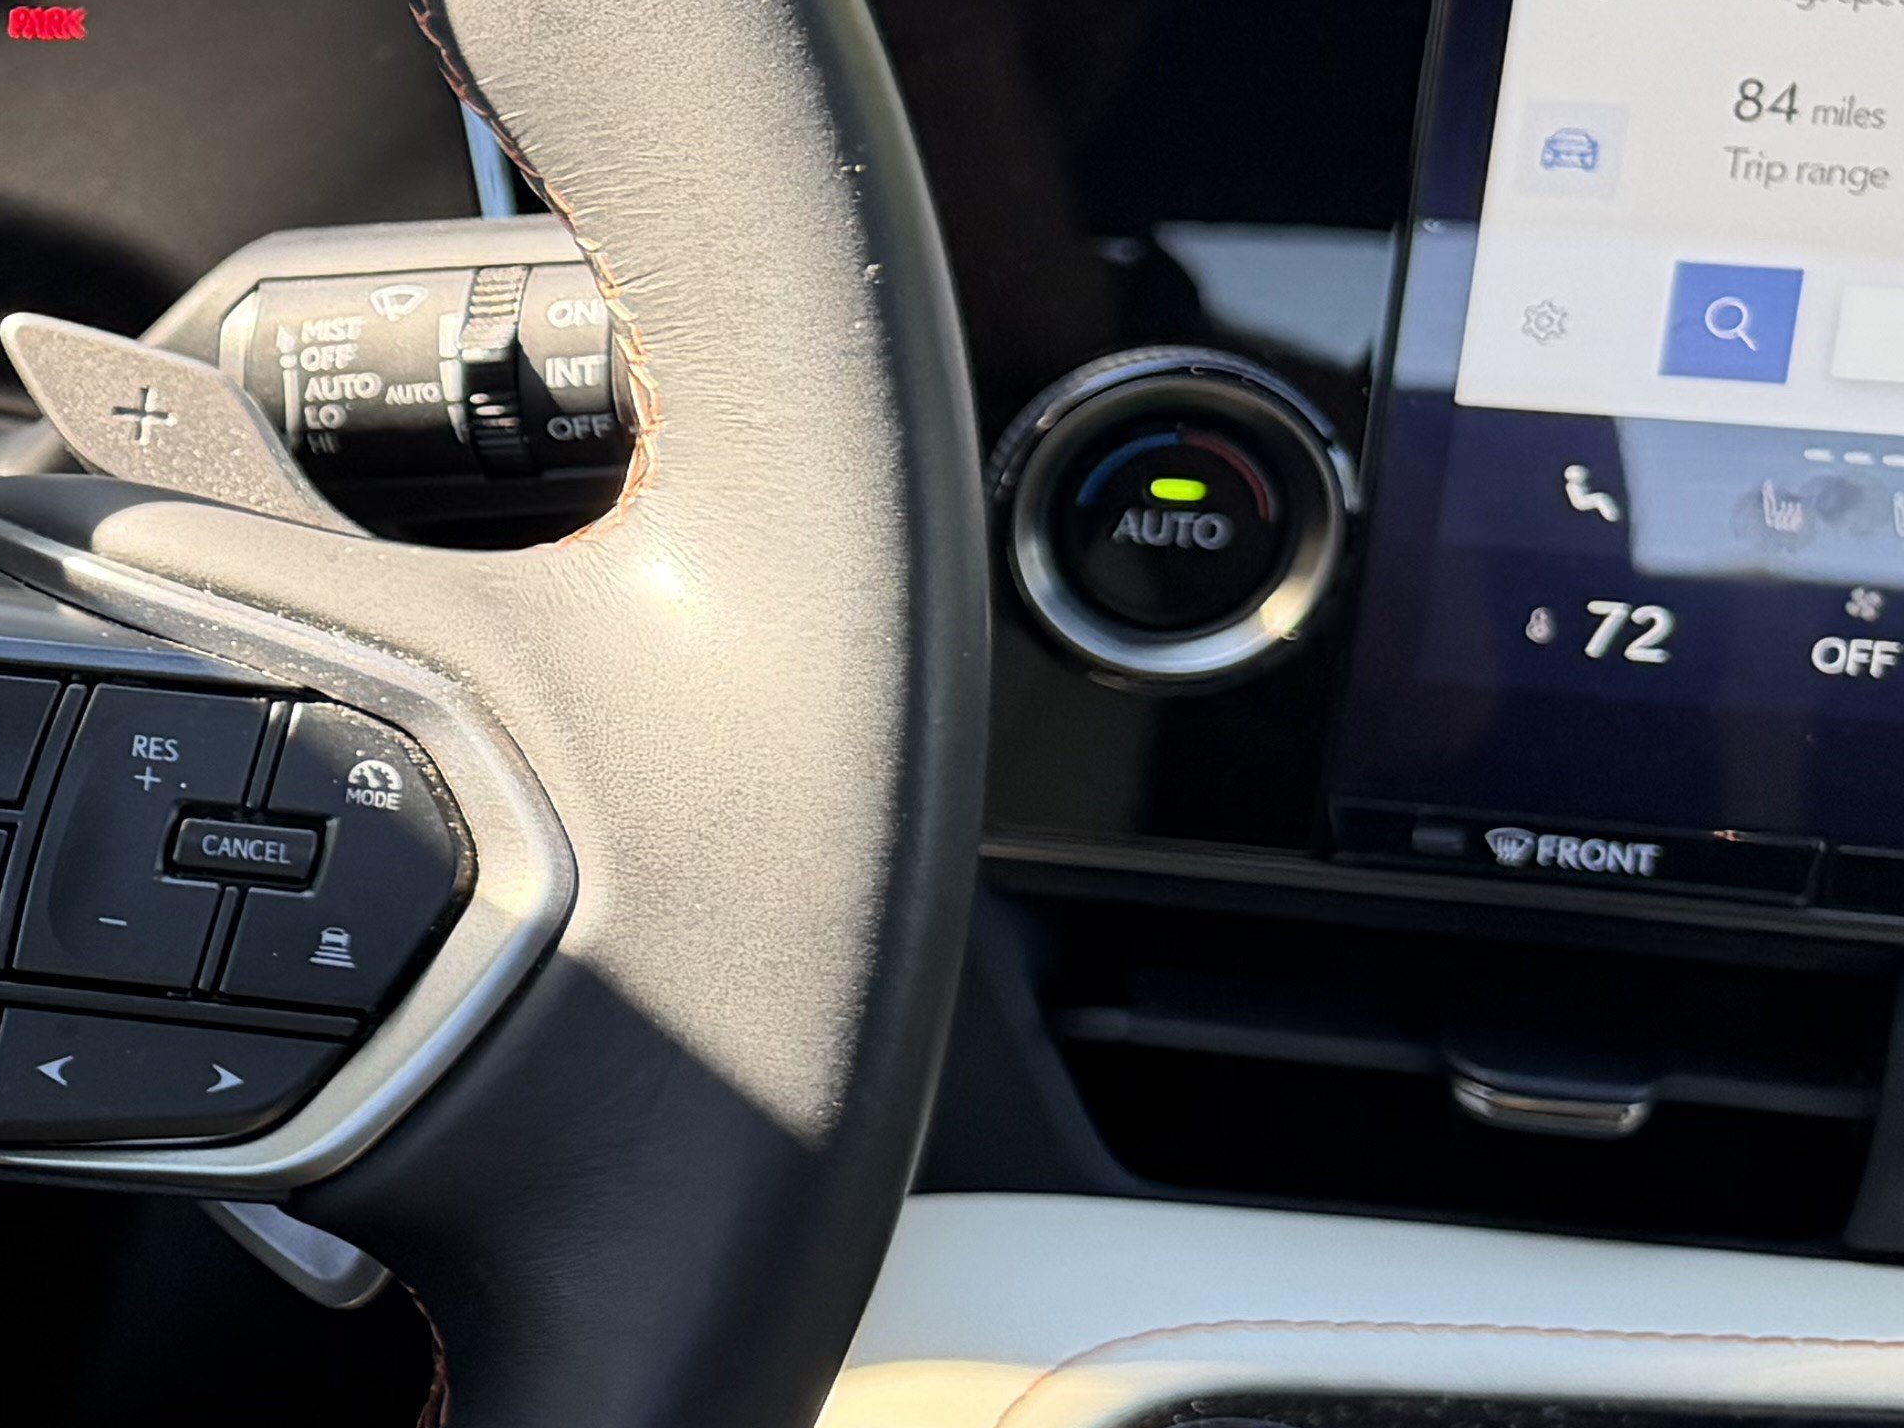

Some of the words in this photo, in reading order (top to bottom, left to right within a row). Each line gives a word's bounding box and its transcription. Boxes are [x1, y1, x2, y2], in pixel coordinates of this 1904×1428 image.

[7, 5, 87, 40] PARK
[1732, 77, 1800, 124] 84
[1810, 95, 1887, 130] miles
[1724, 145, 1787, 194] Trip
[1796, 160, 1891, 196] range
[301, 315, 367, 344] MIST
[546, 299, 608, 329] ON
[300, 343, 358, 372] OFF
[545, 354, 608, 389] INT
[304, 372, 382, 402] AUTO
[384, 381, 443, 406] AUTO
[304, 403, 347, 430] LO
[546, 413, 615, 441] OFF
[1111, 507, 1235, 551] AUTO
[1584, 600, 1676, 664] 72
[1810, 636, 1904, 679] OFF
[130, 734, 180, 763] RES
[345, 788, 401, 812] MODE
[201, 833, 291, 865] CANCEL
[1535, 834, 1664, 876] FRONT
